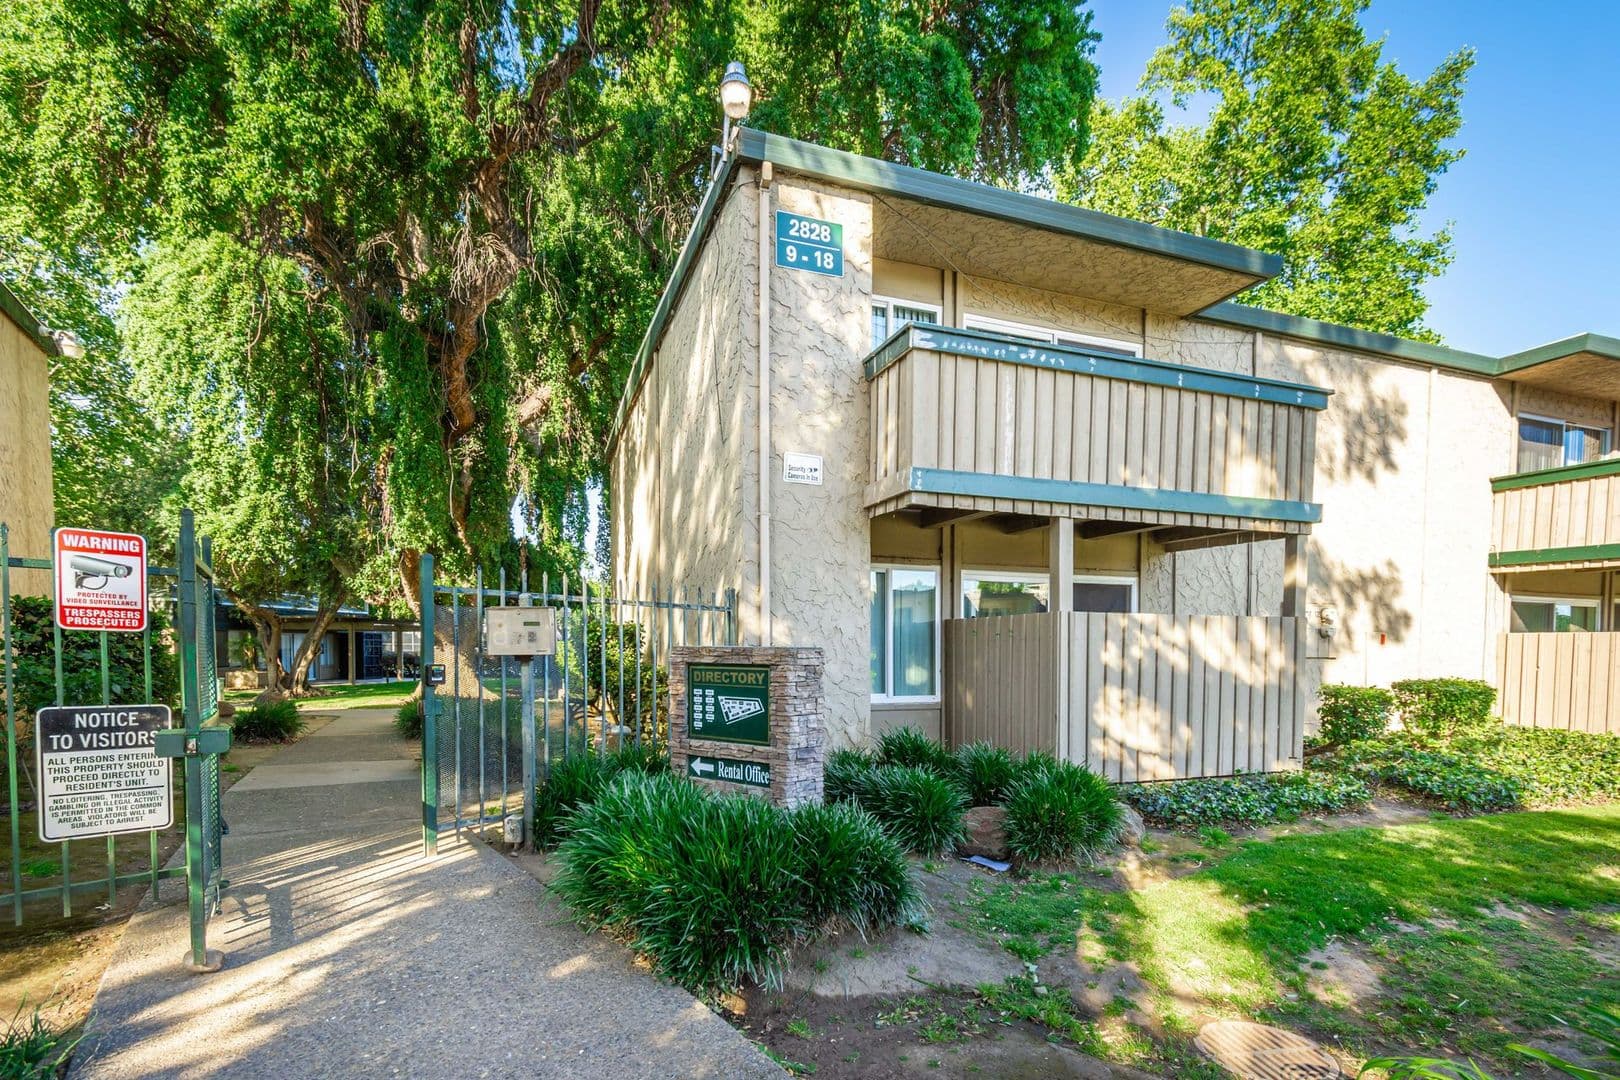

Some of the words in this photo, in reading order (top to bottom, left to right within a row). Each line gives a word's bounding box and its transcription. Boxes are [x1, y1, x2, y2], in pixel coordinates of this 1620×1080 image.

[788, 219, 831, 243] 2828
[785, 245, 797, 262] 9
[814, 250, 834, 269] 18
[62, 534, 140, 552] WARNING
[77, 592, 117, 600] PROTECTED
[89, 598, 138, 607] SURVEILLANCE
[64, 608, 140, 618] TRESPASSERS
[66, 616, 138, 627] PROSECUTED
[693, 671, 766, 685] DIRECTORY
[75, 712, 139, 728] NOTICE
[49, 734, 73, 750] TO
[48, 758, 66, 766] ALL
[70, 754, 115, 764] PERSONS
[118, 752, 157, 761] ENTERIN
[48, 766, 70, 775] THIS
[74, 762, 124, 773] PROPERTY
[127, 760, 164, 770] SHOULD
[718, 762, 744, 780] Rental
[745, 766, 770, 784] Office
[53, 774, 98, 784] PROCEED
[102, 770, 145, 780] DIRECTLY
[66, 780, 122, 792] RESIDENT'S
[125, 778, 149, 787] UNIT.
[49, 802, 88, 812] GAMBLING
[62, 808, 104, 816] PERMITTED
[87, 811, 128, 820] VIOLATORS
[71, 820, 102, 829] SUBJECT
